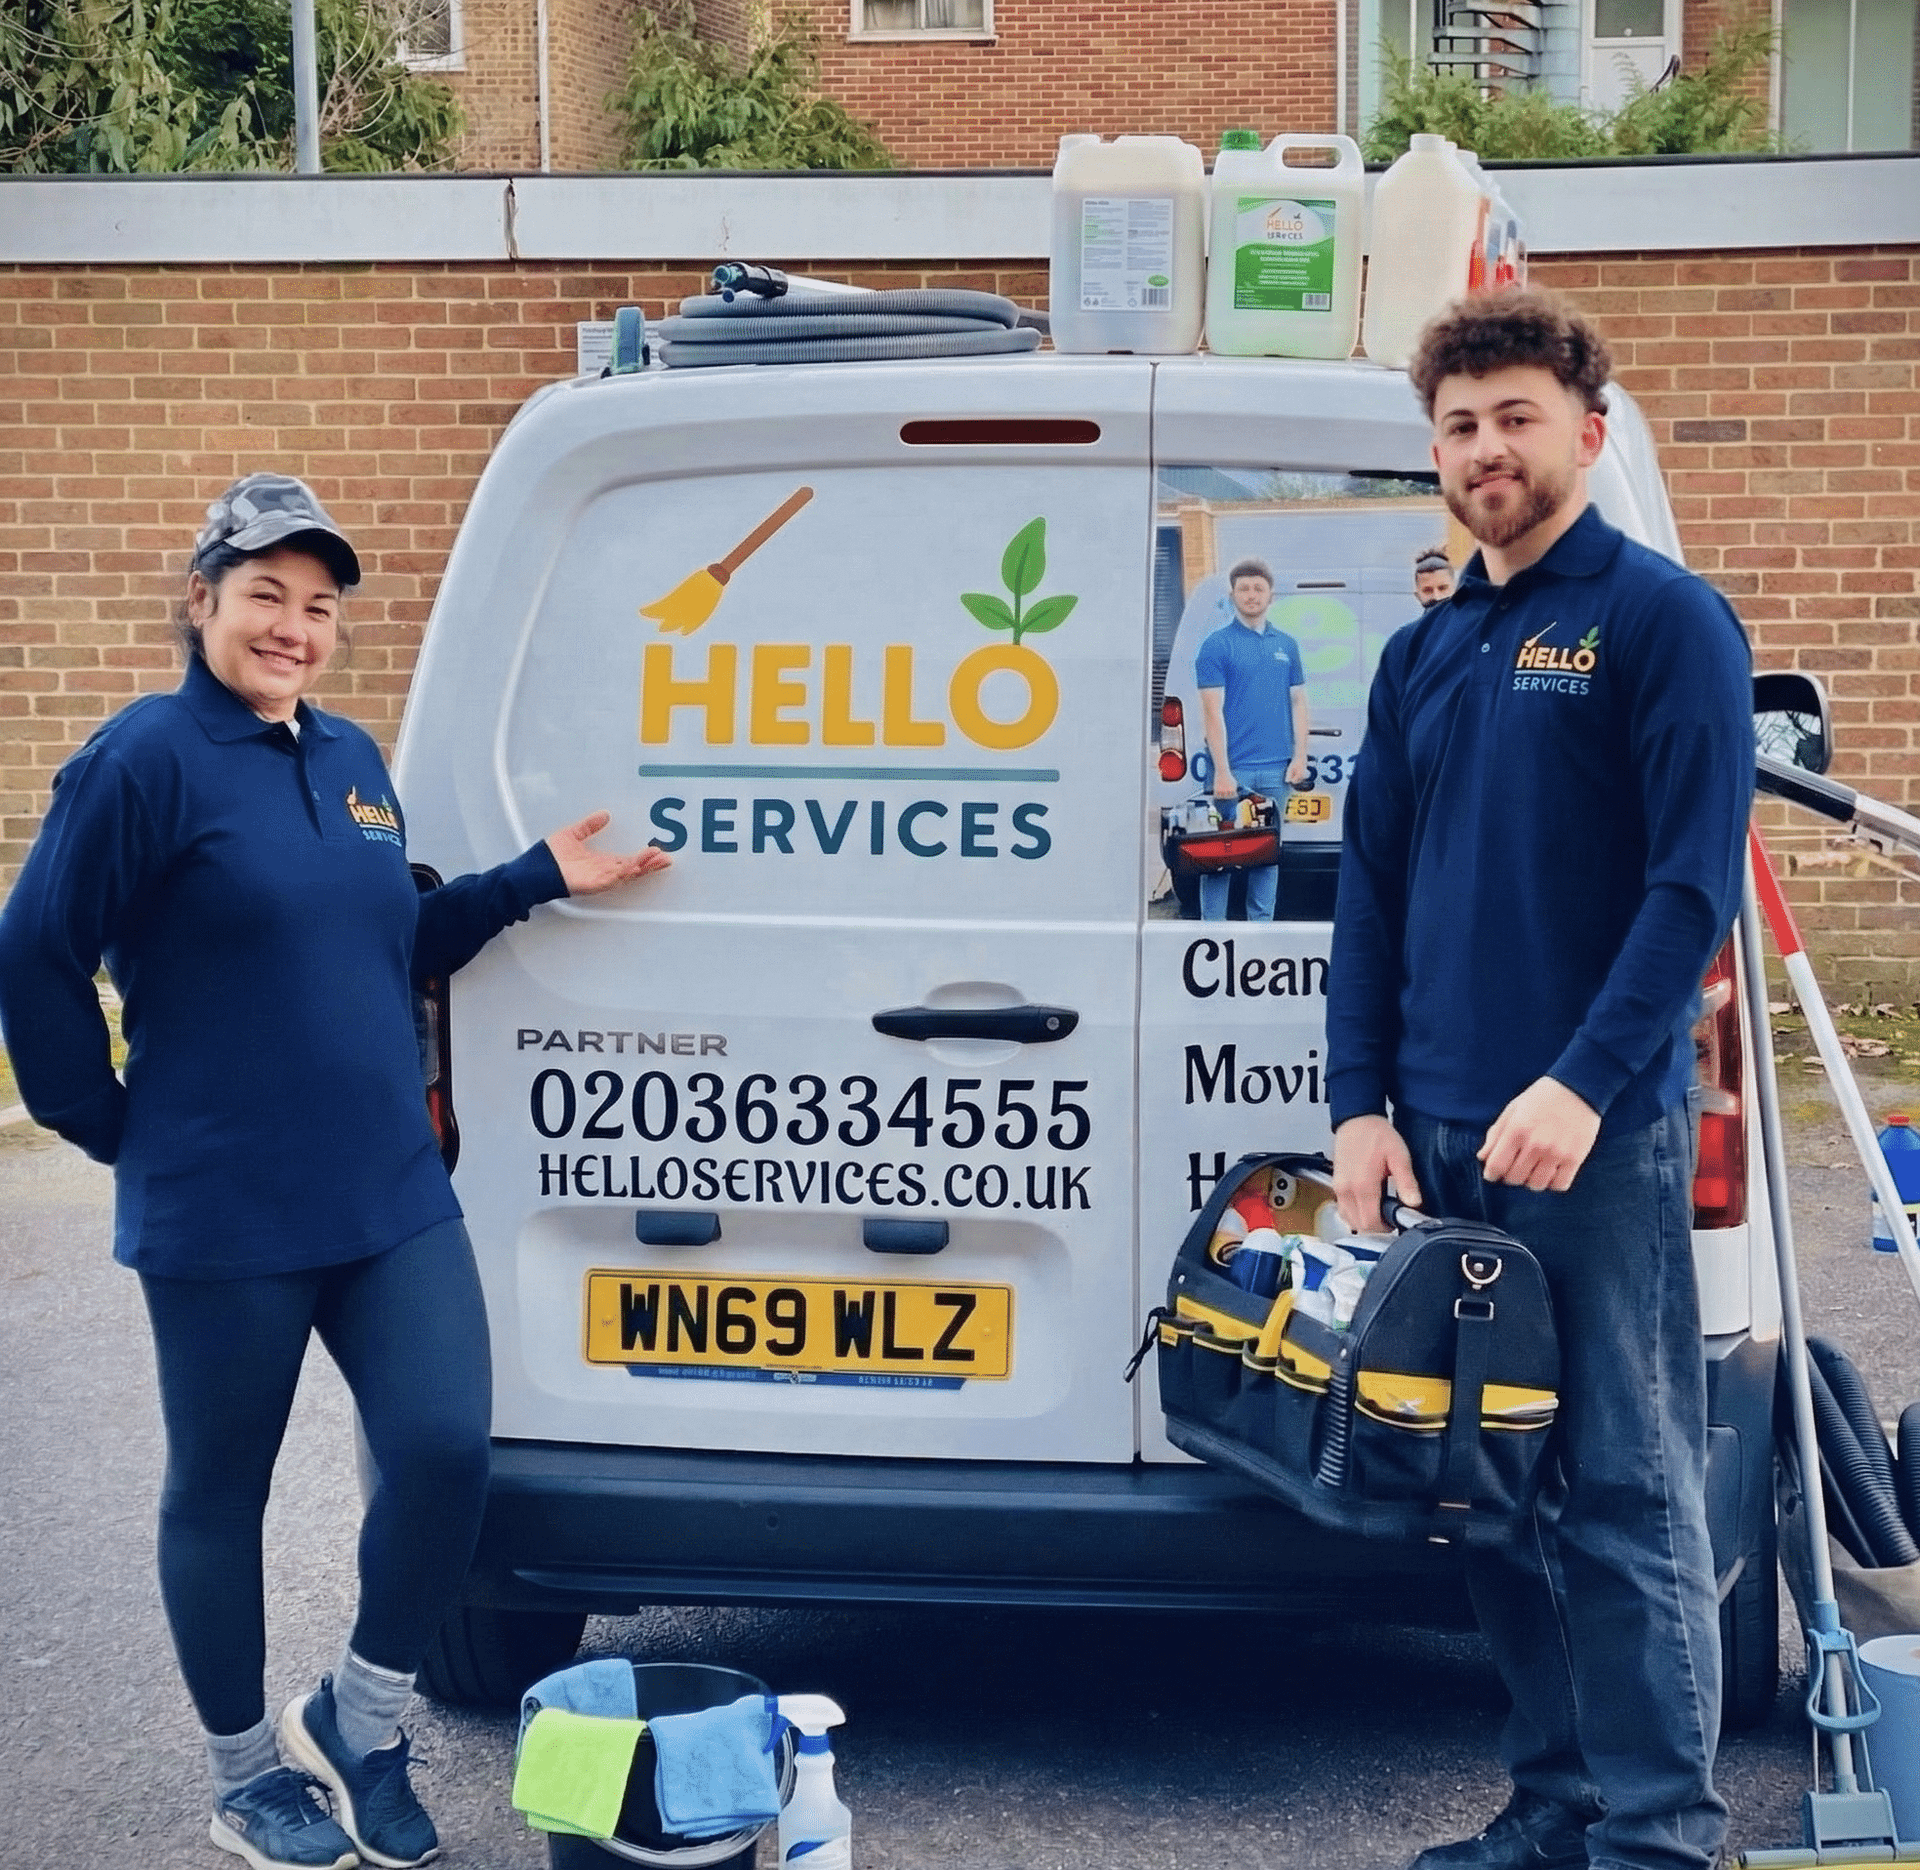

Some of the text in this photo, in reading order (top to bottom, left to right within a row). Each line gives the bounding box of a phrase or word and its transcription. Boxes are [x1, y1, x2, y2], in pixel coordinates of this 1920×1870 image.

[1512, 676, 1590, 696] SERVICES
[1516, 646, 1596, 673] HELLO
[640, 642, 1060, 751] HELLO
[647, 796, 1053, 861] SERVICES
[516, 1027, 730, 1057] PARTNER
[1184, 1043, 1331, 1105] Movi
[529, 1067, 1093, 1152] 02036334555
[538, 1153, 1093, 1211] HELLOSERVICES.CO.UK
[618, 1282, 978, 1363] WN69 WLZ
